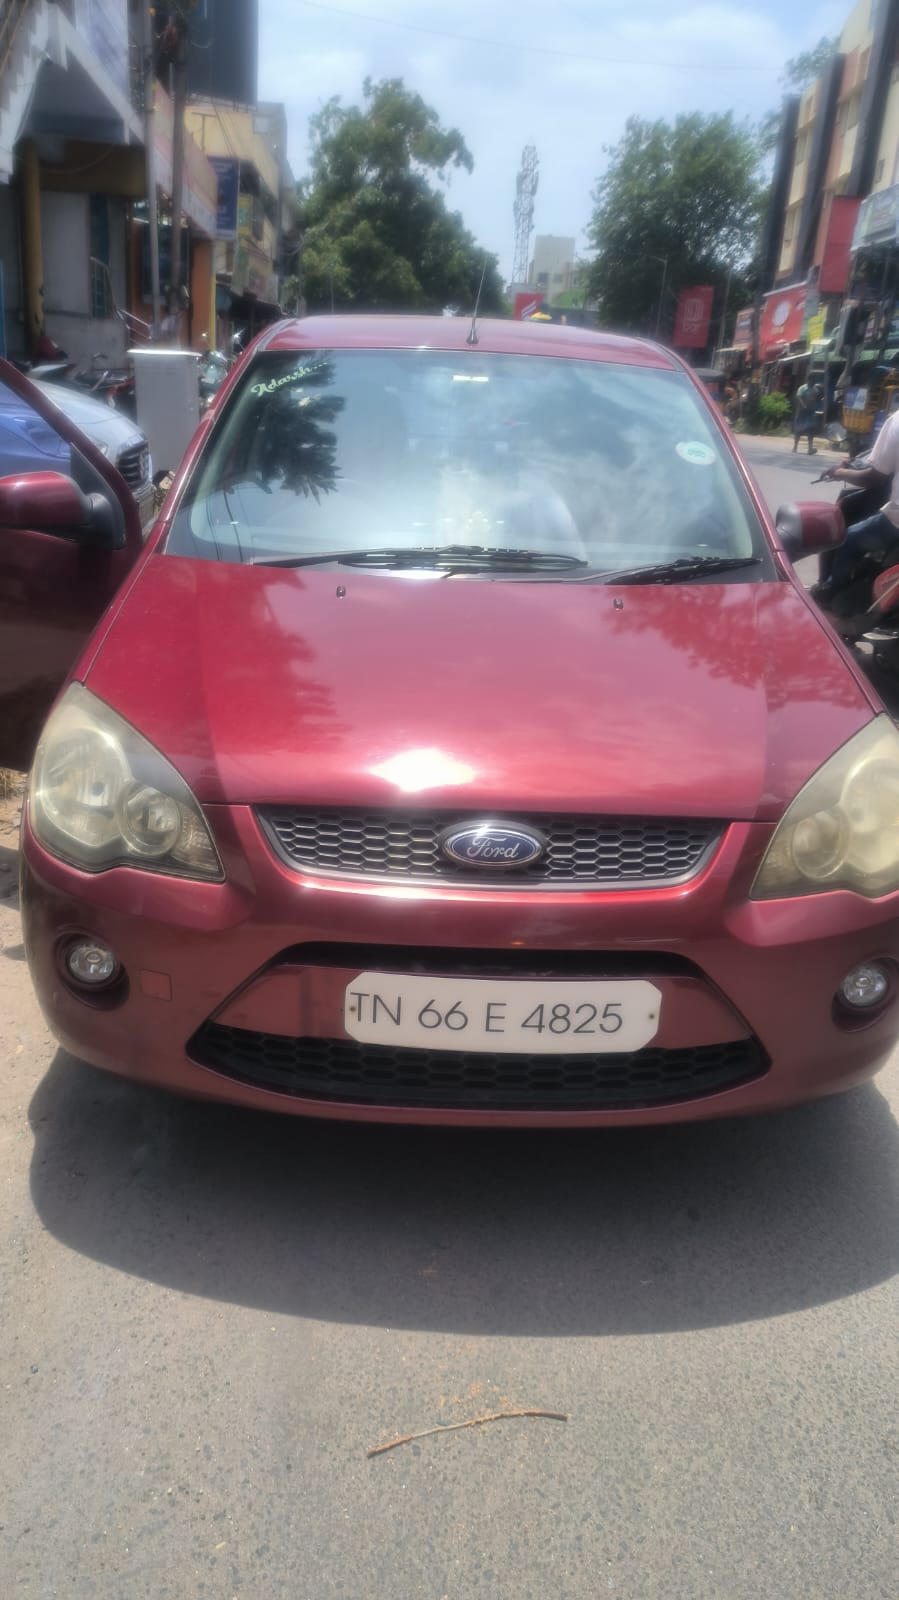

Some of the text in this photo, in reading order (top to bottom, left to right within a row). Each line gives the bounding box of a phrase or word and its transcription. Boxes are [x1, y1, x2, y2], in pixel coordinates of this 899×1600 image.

[466, 836, 520, 858] Ford
[350, 991, 623, 1034] TN 66 E 4825
